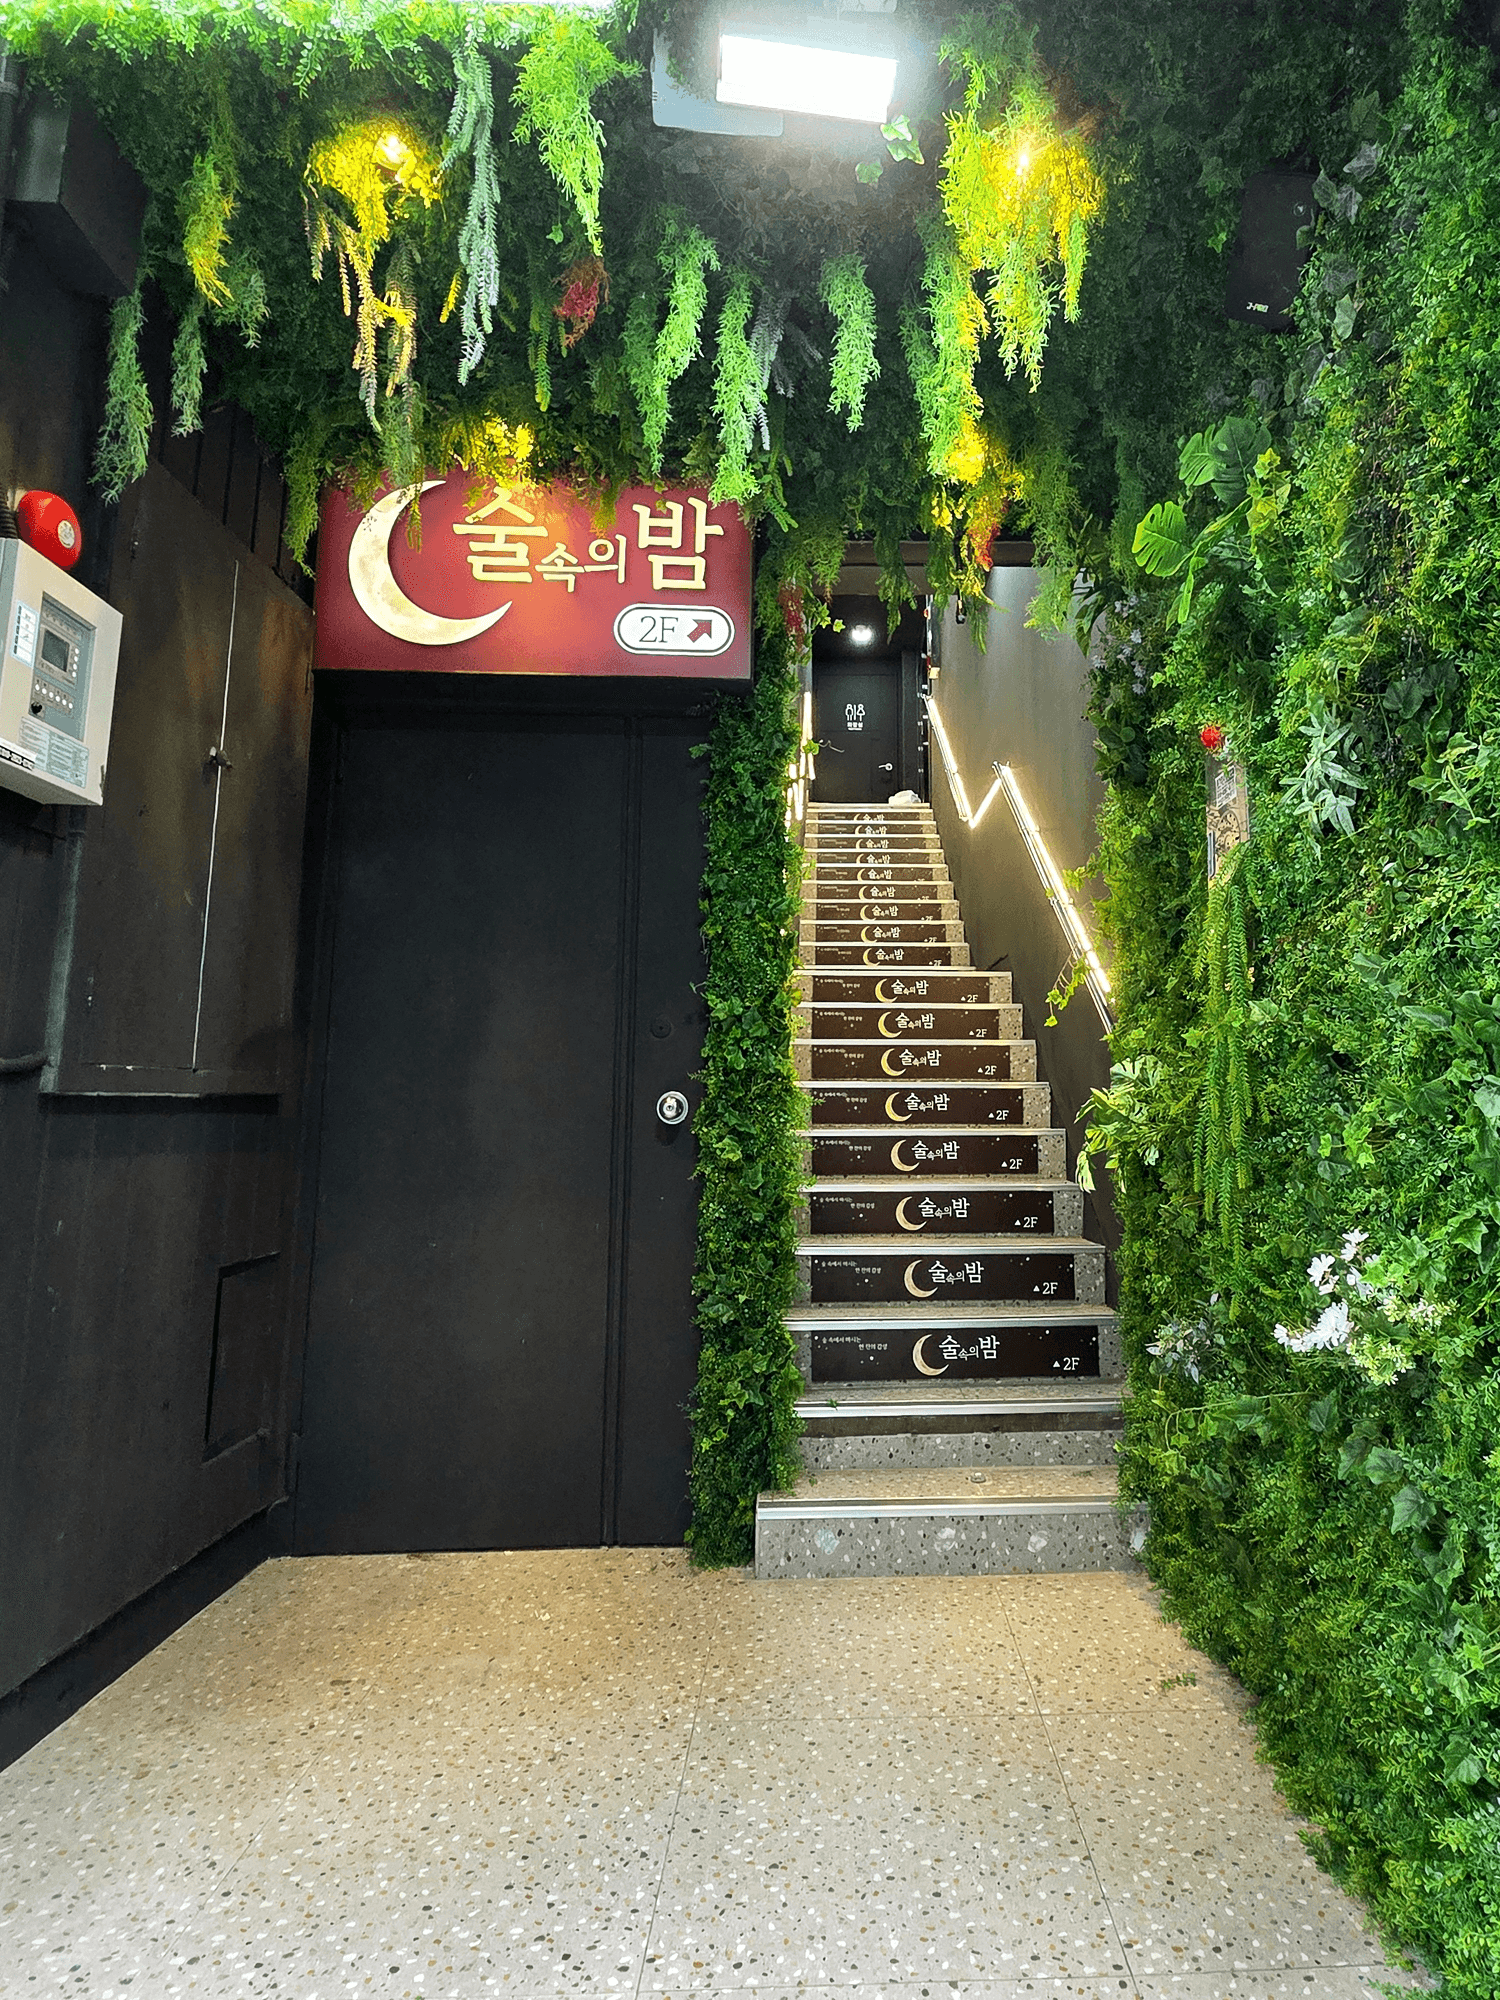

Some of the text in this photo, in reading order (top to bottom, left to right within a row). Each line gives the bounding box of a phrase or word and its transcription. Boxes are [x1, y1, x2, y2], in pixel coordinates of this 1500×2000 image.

[638, 616, 679, 643] 2F
[976, 1029, 987, 1037] 2F
[985, 1066, 997, 1075] 2F
[996, 1110, 1009, 1120] 2F
[1010, 1159, 1023, 1169] 2F
[1023, 1217, 1038, 1227] 2F
[1043, 1282, 1058, 1294] 2F
[1064, 1358, 1079, 1370] 2F
